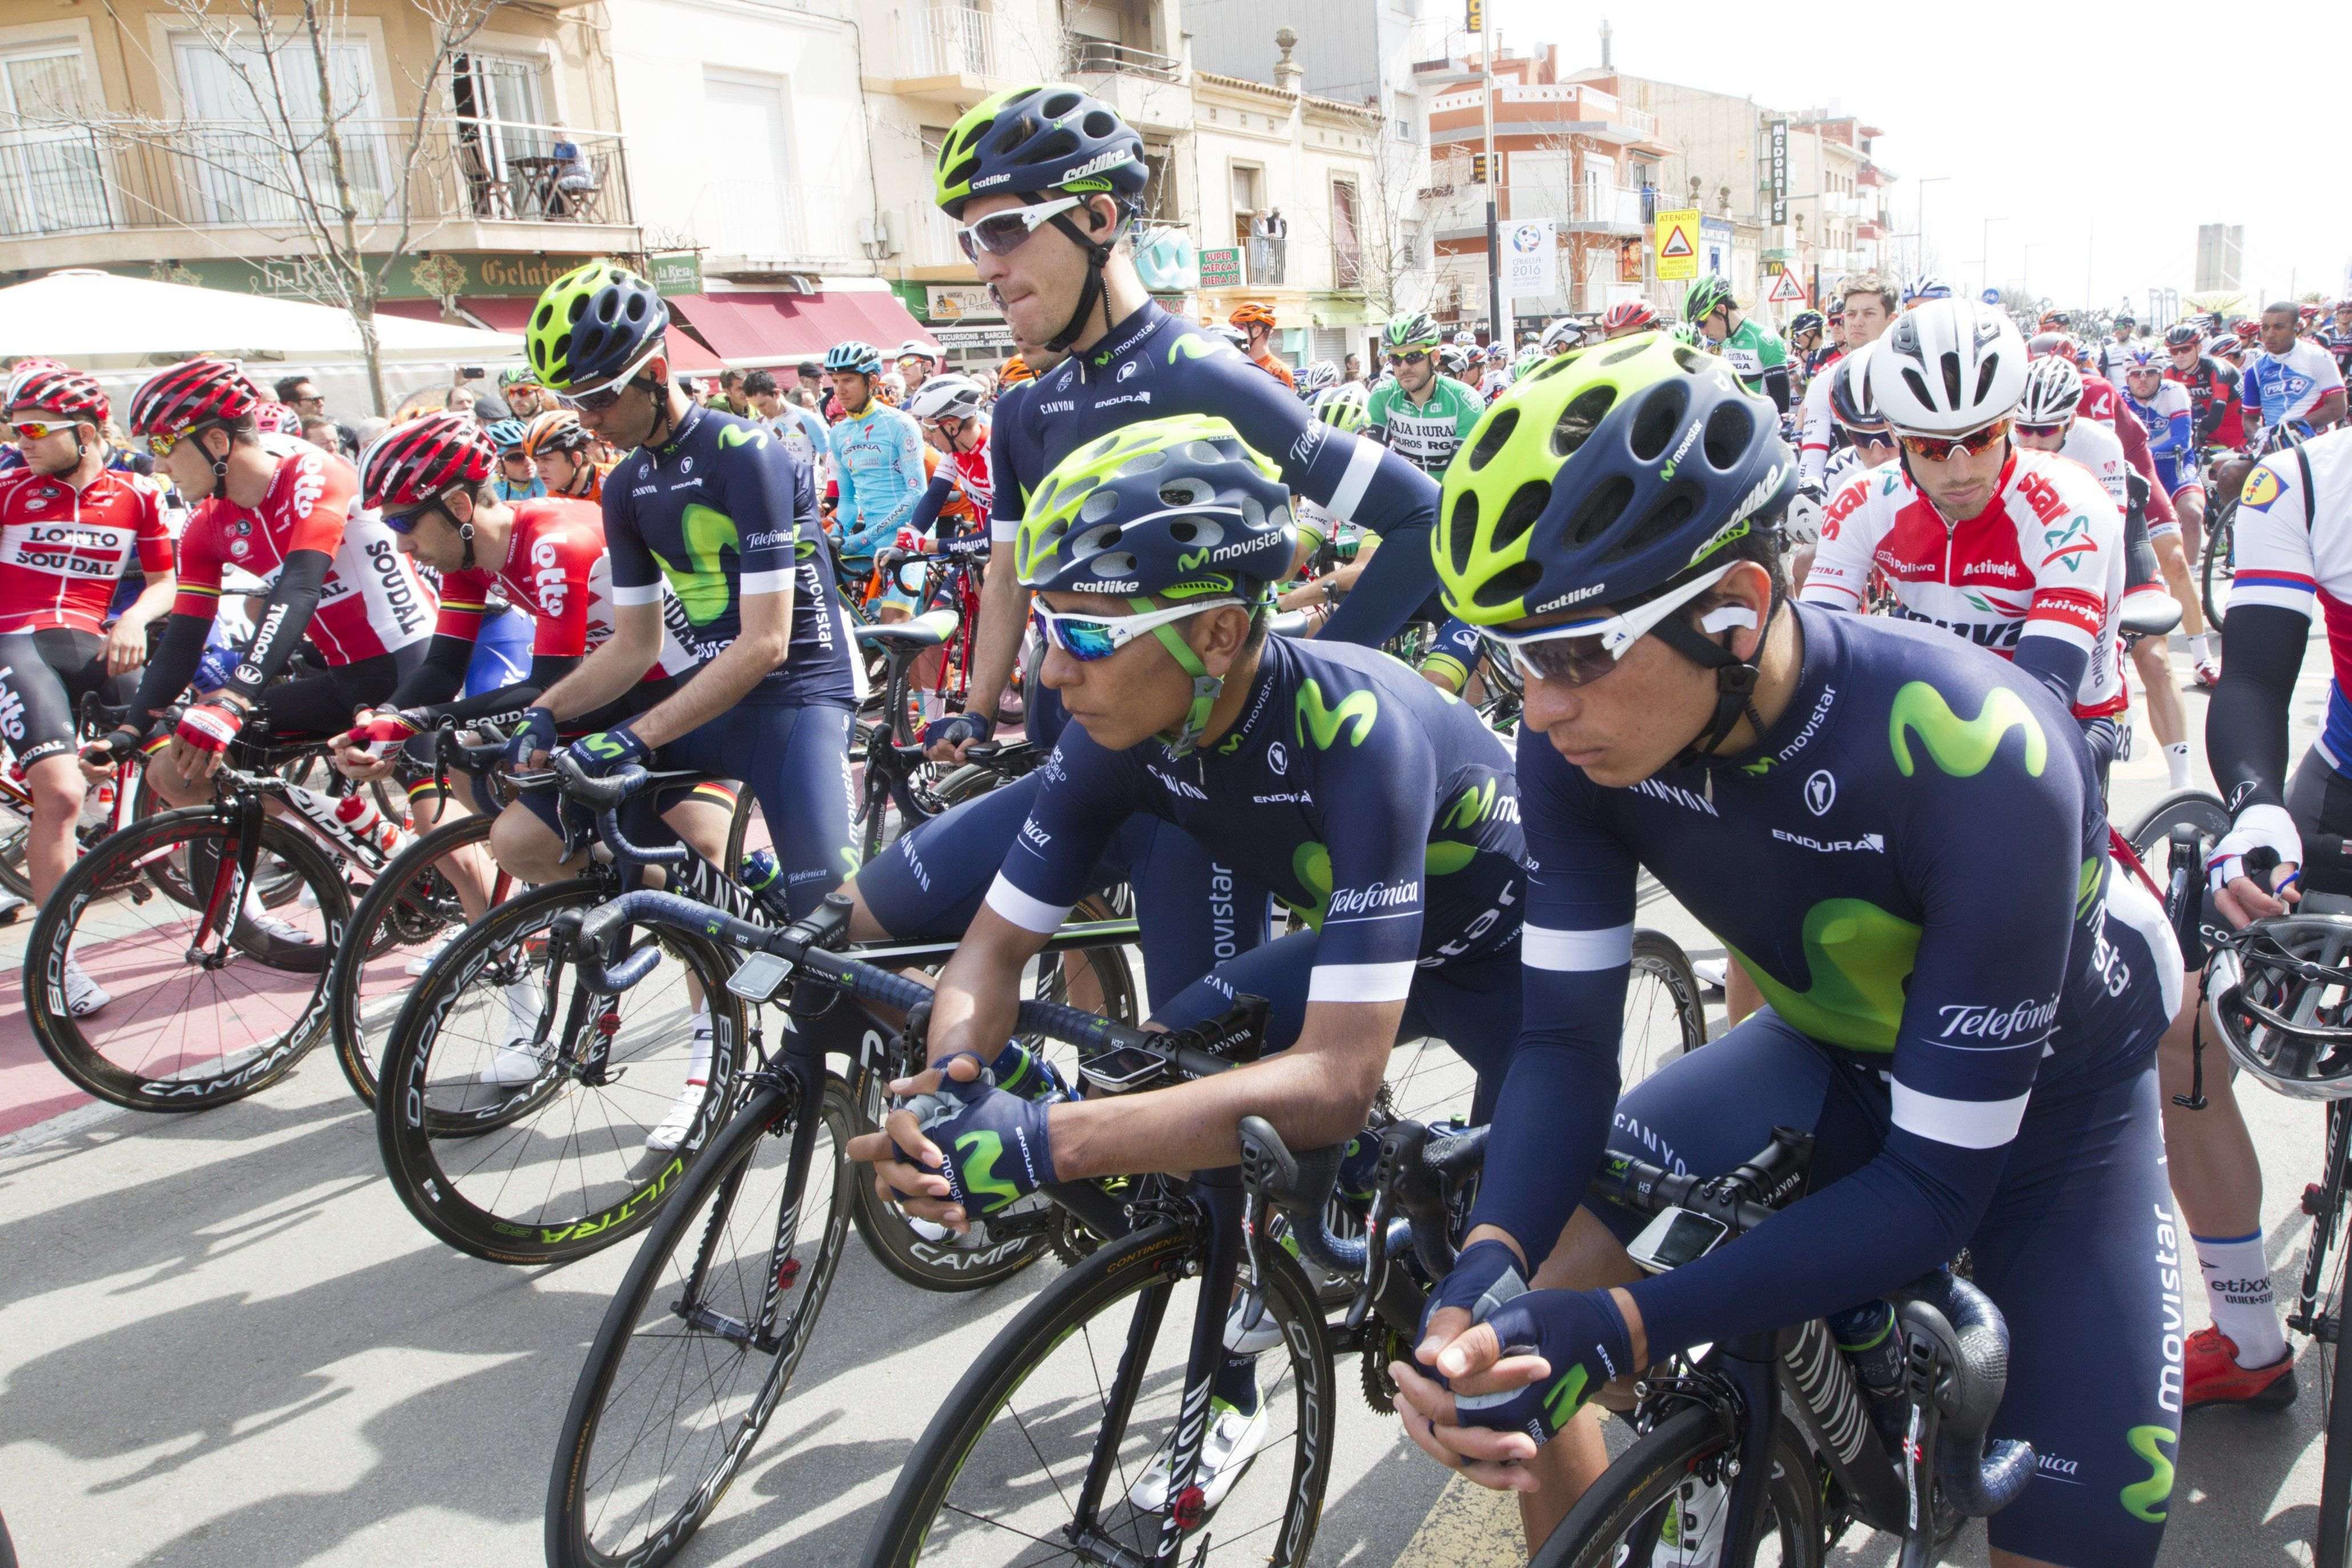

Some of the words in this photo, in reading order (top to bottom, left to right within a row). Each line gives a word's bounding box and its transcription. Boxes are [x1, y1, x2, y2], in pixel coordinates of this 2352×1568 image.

[1063, 149, 1125, 183] catlike
[972, 173, 1011, 190] catlike
[668, 265, 691, 277] Riera
[1202, 263, 1239, 272] MERCAT
[1206, 252, 1232, 261] SUPER
[1513, 256, 1541, 265] CALELLA
[1513, 265, 1541, 276] 2016
[1202, 275, 1227, 285] RIERA
[1228, 274, 1239, 284] 32
[937, 332, 978, 342] EXCURSIONS
[1114, 320, 1156, 356] movistar
[573, 369, 599, 384] catlike
[1040, 400, 1074, 415] CANYON
[1095, 392, 1150, 408] ENDURA
[172, 416, 190, 431] lotto
[678, 417, 701, 445] movistar
[1673, 419, 1703, 464] movistar
[267, 467, 281, 499] SOUDAL
[381, 462, 403, 496] LAZER
[417, 484, 437, 500] lotto
[632, 484, 658, 497] CANYON
[671, 478, 700, 491] ENDURA
[1821, 480, 1871, 541] star
[2017, 471, 2071, 526] star
[876, 503, 909, 533] ASTANA
[1689, 464, 1780, 565] catlike
[30, 527, 118, 547] LOTTO
[507, 532, 518, 564] SOUDAL
[1213, 527, 1285, 563] movistar
[16, 551, 114, 576] SOUDAL
[531, 532, 568, 617] lotto
[1963, 560, 2017, 580] Activejet
[366, 539, 427, 636] SOUDAL
[1072, 580, 1139, 594] catlike
[1535, 583, 1605, 615] catlike
[802, 563, 833, 651] movistar
[250, 602, 289, 664] SOUDAL
[2091, 629, 2108, 688] Paliwa
[189, 717, 222, 738] SOUDAL
[198, 711, 224, 729] LOTTO
[1779, 684, 1837, 761] movistar
[1054, 745, 1064, 763] UCI
[840, 751, 859, 845] movistar
[876, 803, 886, 840] movistar
[1772, 828, 1884, 854] ENDURA
[222, 861, 245, 945] RIDLEY
[436, 927, 487, 976] COMPETITION
[736, 933, 748, 944] H32
[47, 892, 90, 1017] BORA
[1111, 1037, 1124, 1048] H32
[1207, 1029, 1252, 1056] CANYON
[686, 1014, 732, 1150] BORA
[1015, 1126, 1040, 1188] ENDURA
[941, 1154, 964, 1208] movista
[542, 1158, 684, 1245] ULTRA
[2154, 1203, 2183, 1413] movistar
